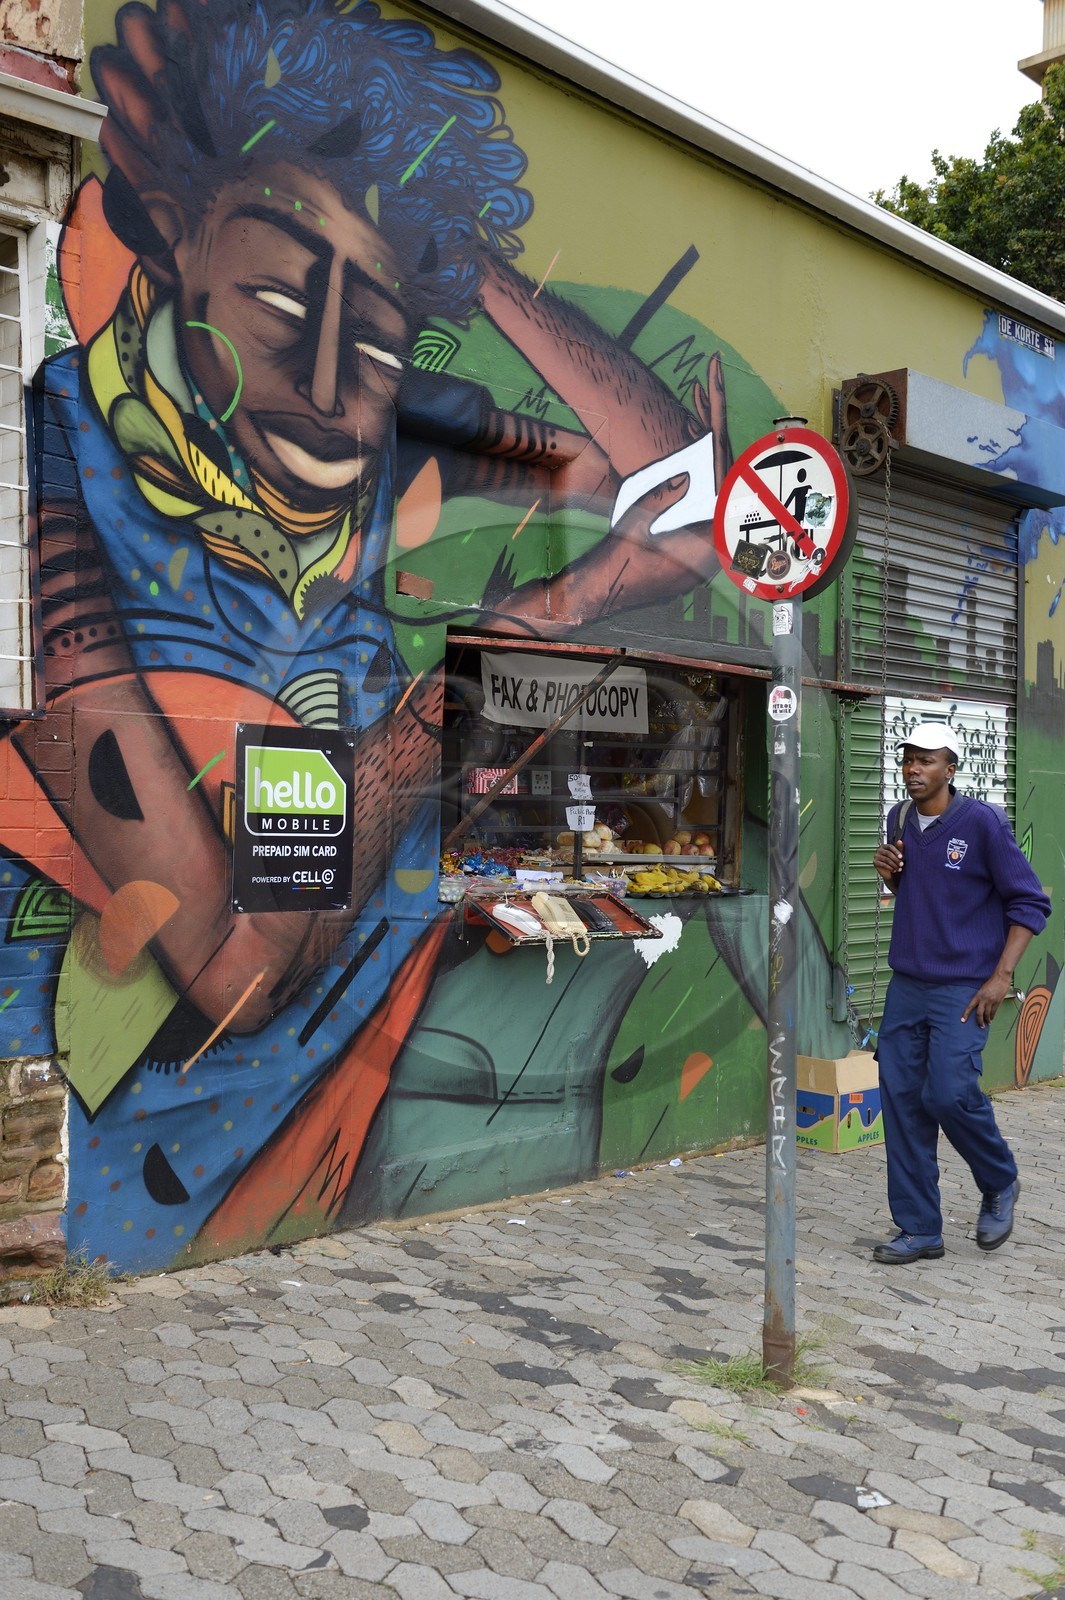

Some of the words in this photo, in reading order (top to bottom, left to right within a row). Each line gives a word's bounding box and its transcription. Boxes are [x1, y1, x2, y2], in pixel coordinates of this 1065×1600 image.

[1001, 317, 1012, 336] DE
[1014, 323, 1041, 349] KORTE
[1044, 338, 1053, 355] ST
[491, 673, 524, 711] FAX
[525, 679, 539, 713] &
[254, 766, 336, 810] hello
[261, 818, 330, 831] MOBILE
[252, 845, 292, 857] PREPAID
[293, 845, 310, 857] SIM
[312, 845, 337, 857] CARD
[251, 876, 282, 884] POWERED
[796, 1135, 818, 1146] PPLES
[857, 1131, 880, 1144] APPLES
